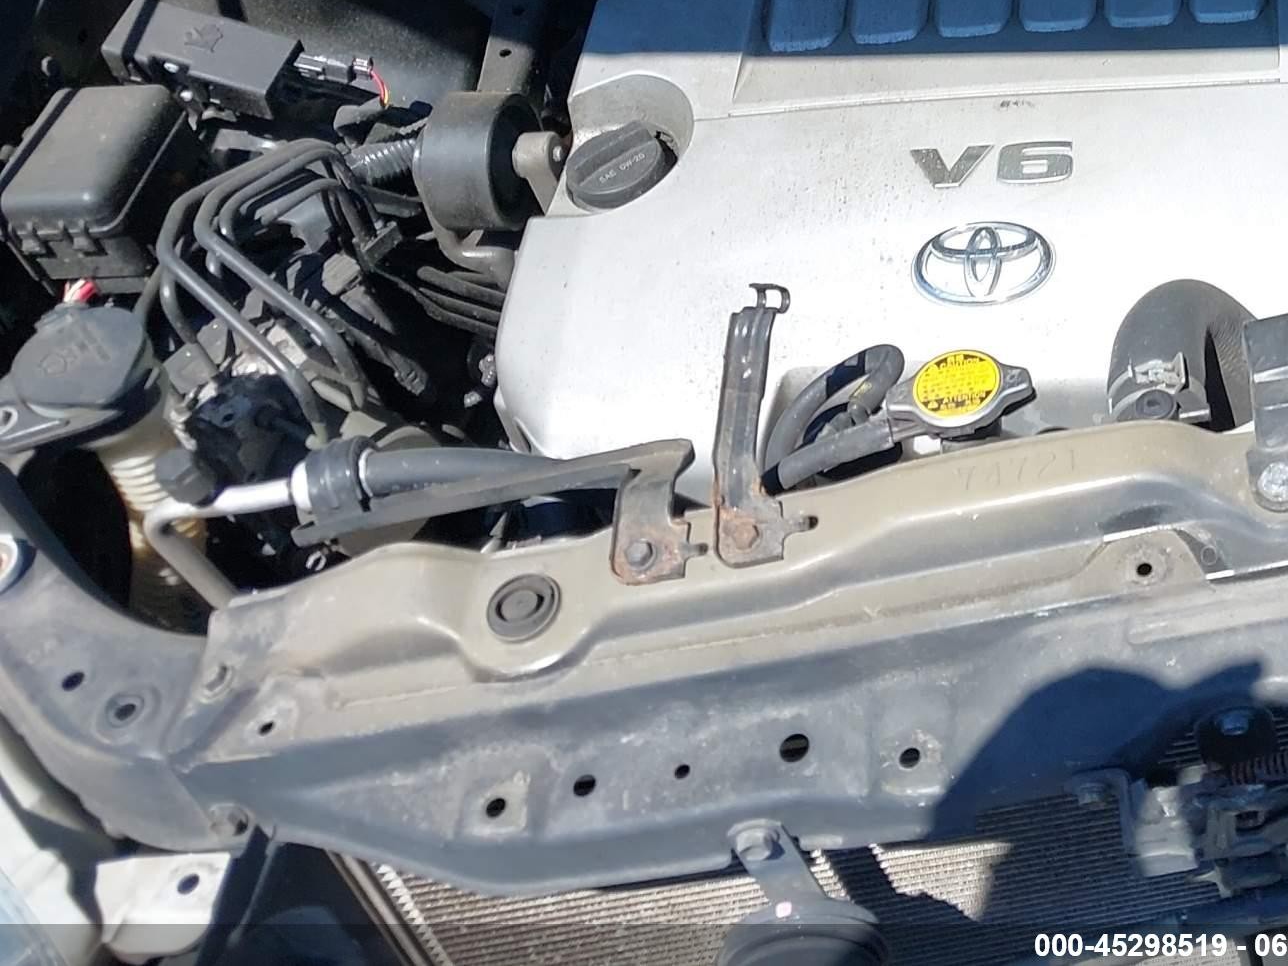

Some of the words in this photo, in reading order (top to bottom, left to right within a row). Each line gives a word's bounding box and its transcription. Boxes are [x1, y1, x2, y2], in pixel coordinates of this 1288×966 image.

[909, 140, 1074, 190] V6
[599, 169, 617, 183] SAE
[939, 357, 978, 369] CAUTION
[943, 390, 984, 404] ATTENTION
